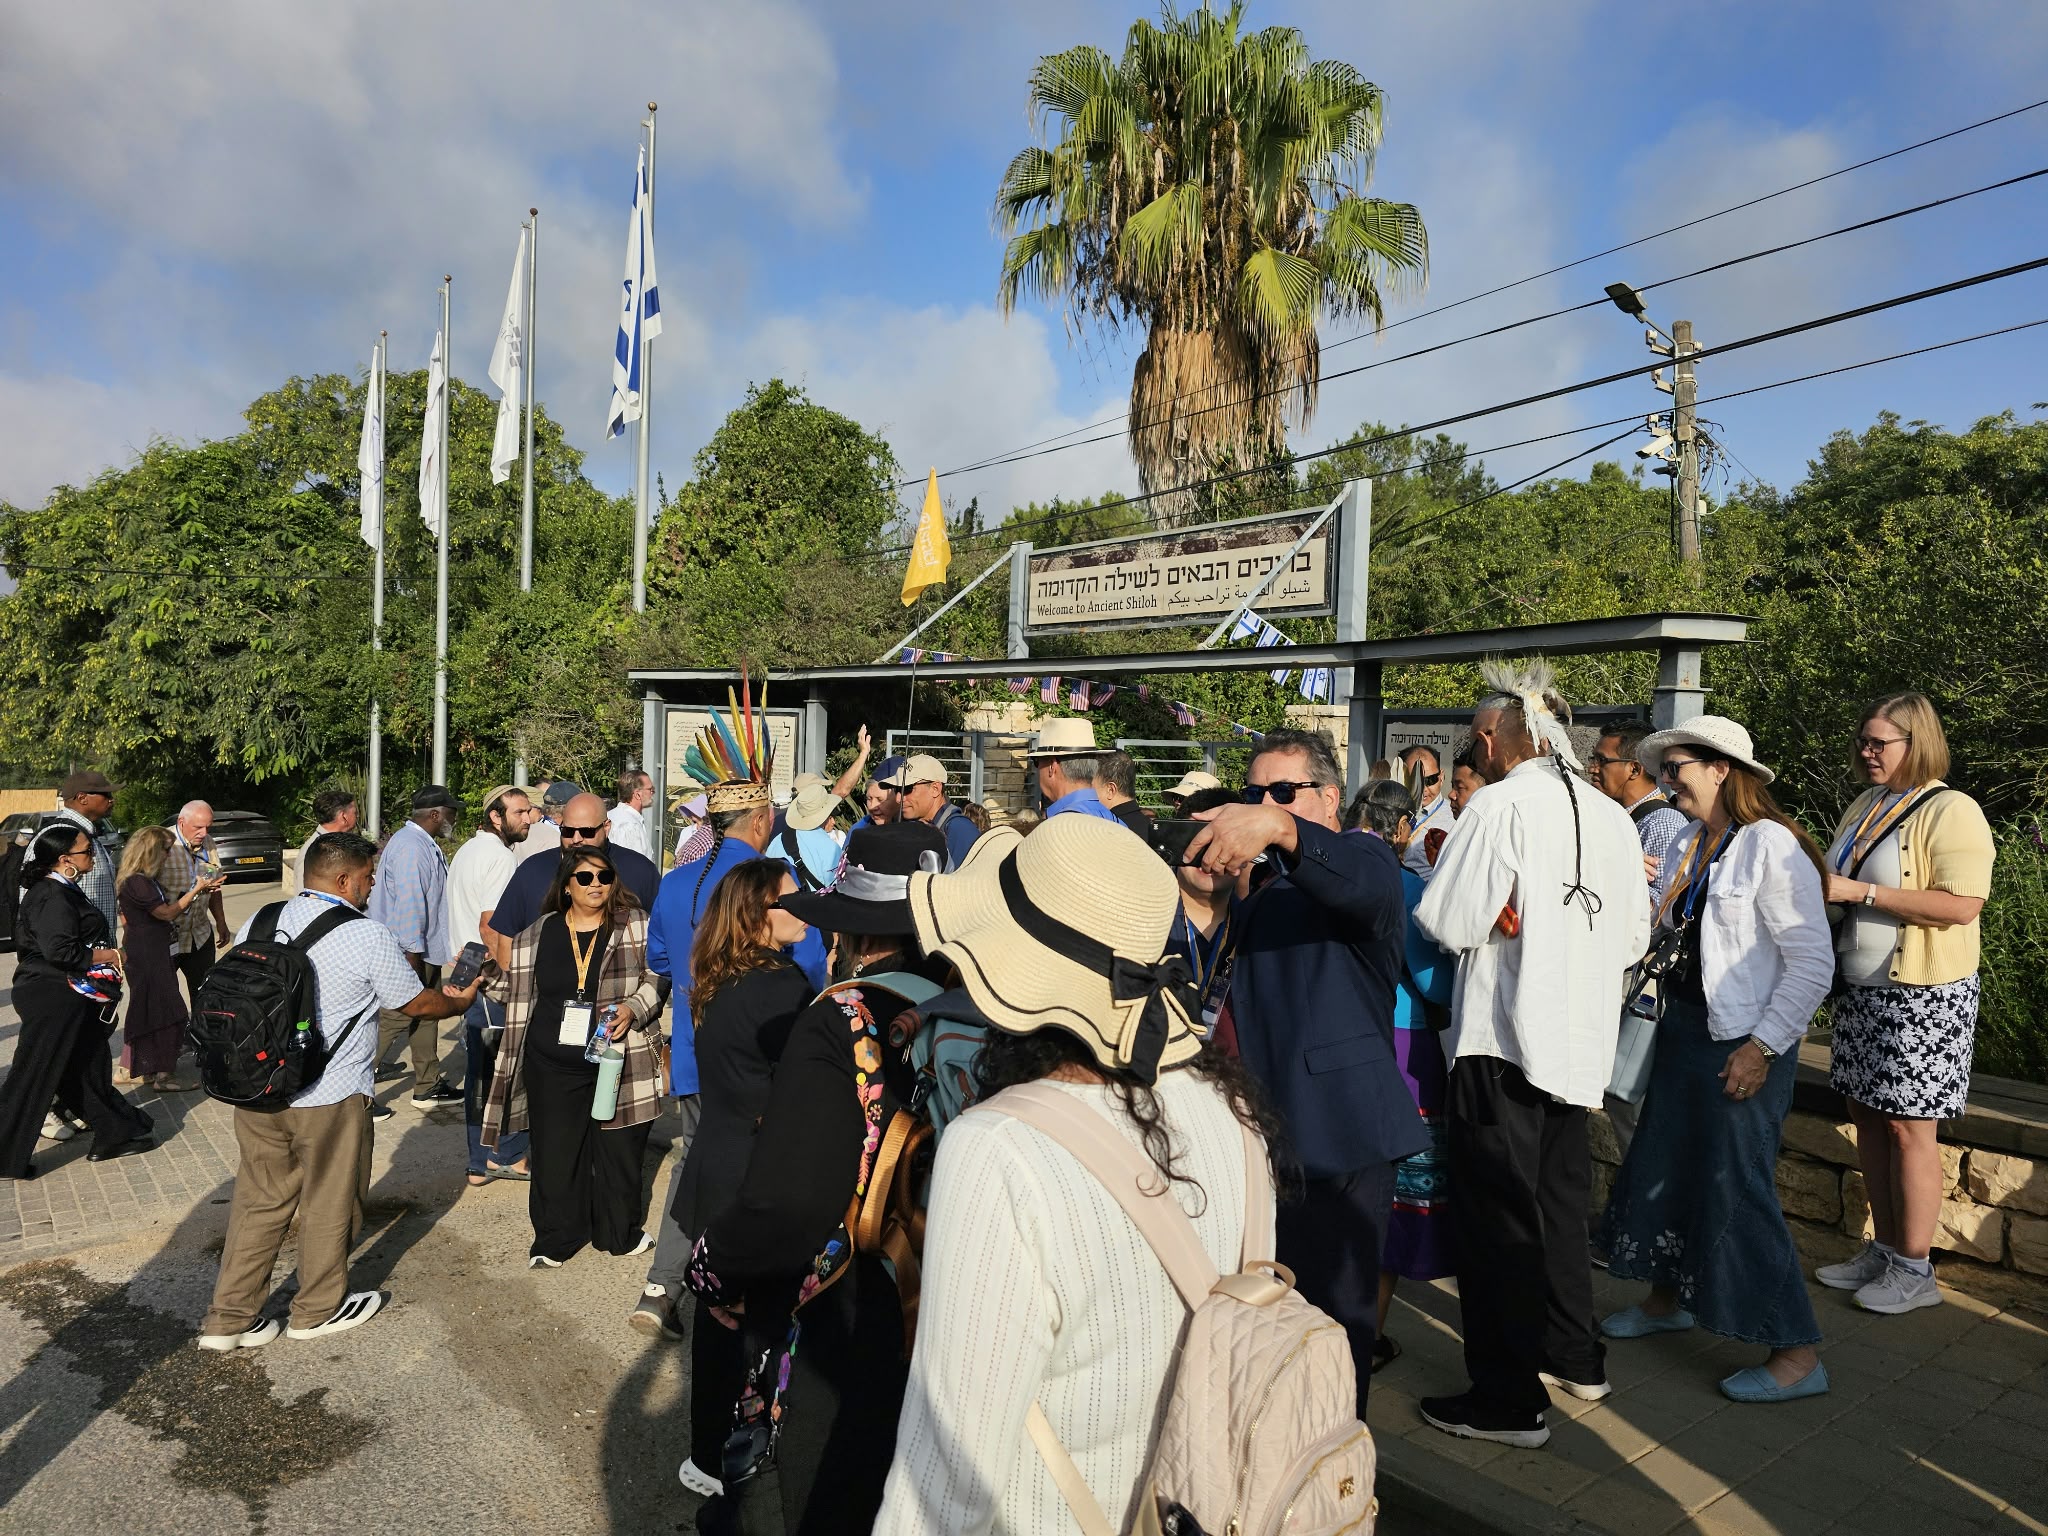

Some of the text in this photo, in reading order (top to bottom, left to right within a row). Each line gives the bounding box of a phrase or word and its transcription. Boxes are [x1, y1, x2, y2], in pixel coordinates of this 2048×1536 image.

[1168, 561, 1229, 585] הבאים
[1194, 586, 1230, 606] تراحب
[1279, 579, 1310, 600] شيلو
[1037, 594, 1157, 616] Welcome to Ancient Shiloh
